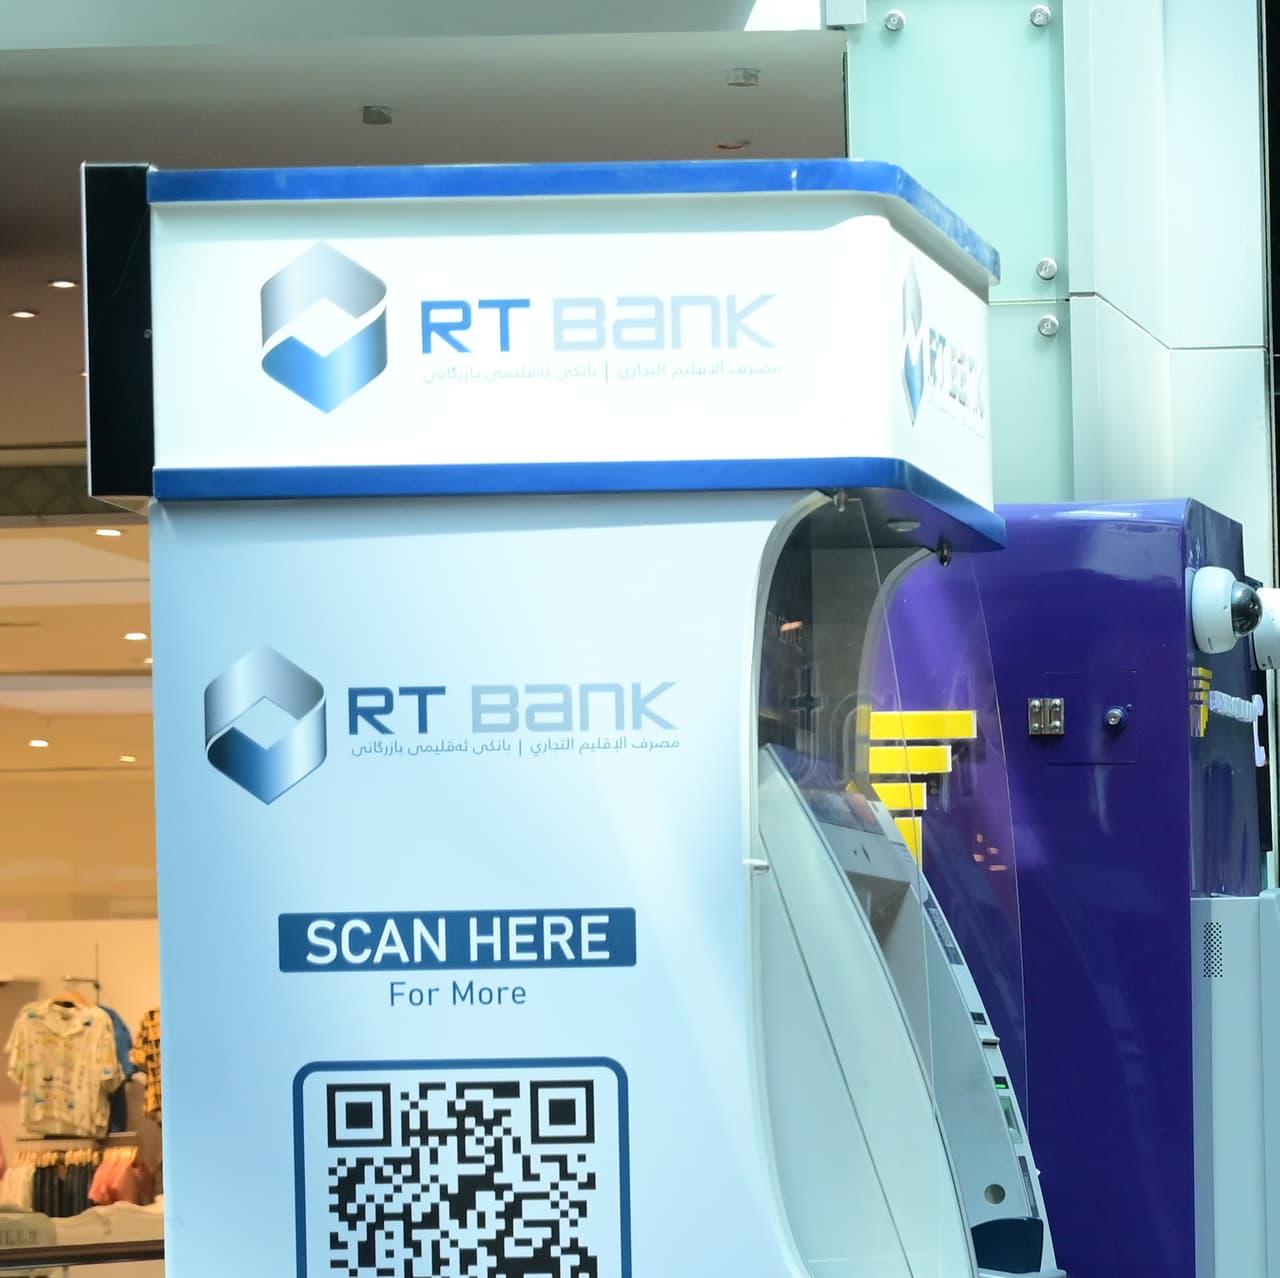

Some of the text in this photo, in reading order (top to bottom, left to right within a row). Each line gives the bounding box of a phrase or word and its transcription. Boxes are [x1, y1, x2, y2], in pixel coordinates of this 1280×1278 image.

[421, 298, 530, 354] RT
[348, 685, 446, 736] RT
[306, 915, 611, 965] SCAN HERE
[390, 980, 527, 1007] For More
